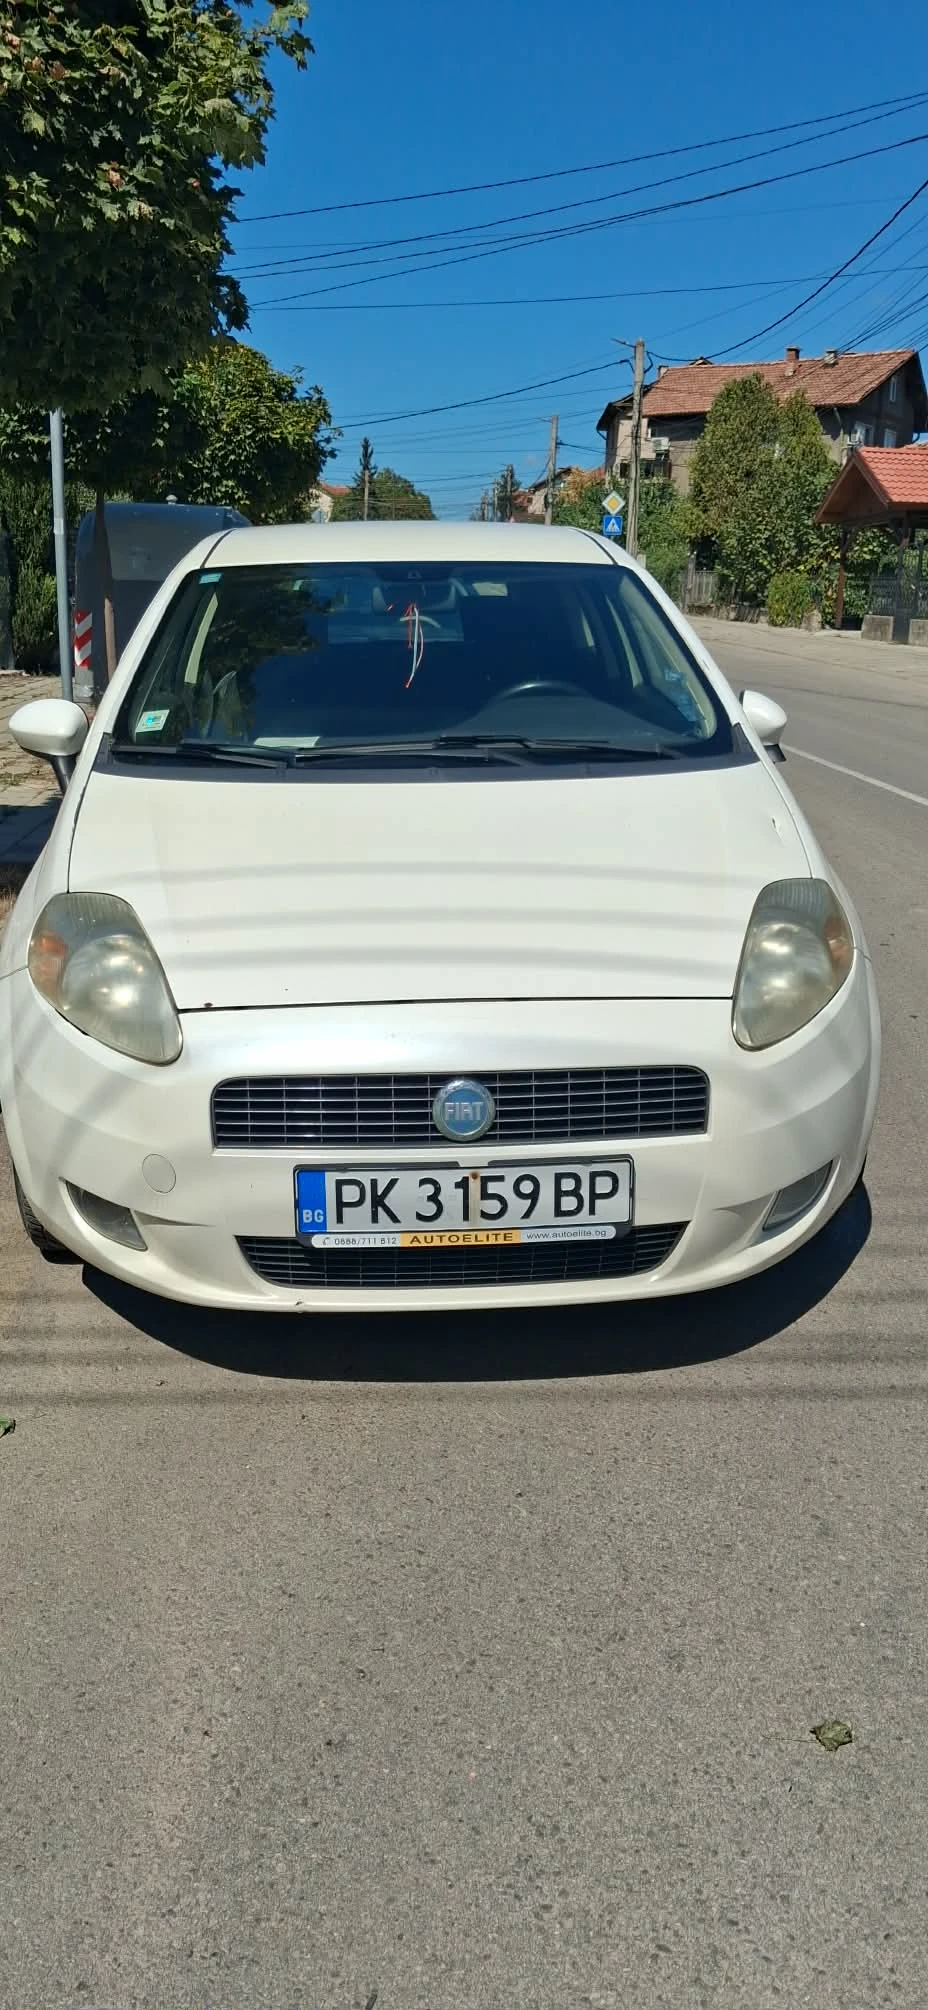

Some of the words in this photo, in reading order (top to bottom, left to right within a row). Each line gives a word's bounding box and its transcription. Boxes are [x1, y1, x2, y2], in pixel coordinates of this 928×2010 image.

[445, 1102, 484, 1120] FIAT
[302, 1209, 324, 1223] BG
[335, 1177, 401, 1225] PK
[415, 1173, 541, 1222] 3159
[553, 1170, 620, 1218] BP
[409, 1231, 513, 1245] AUTOELITE
